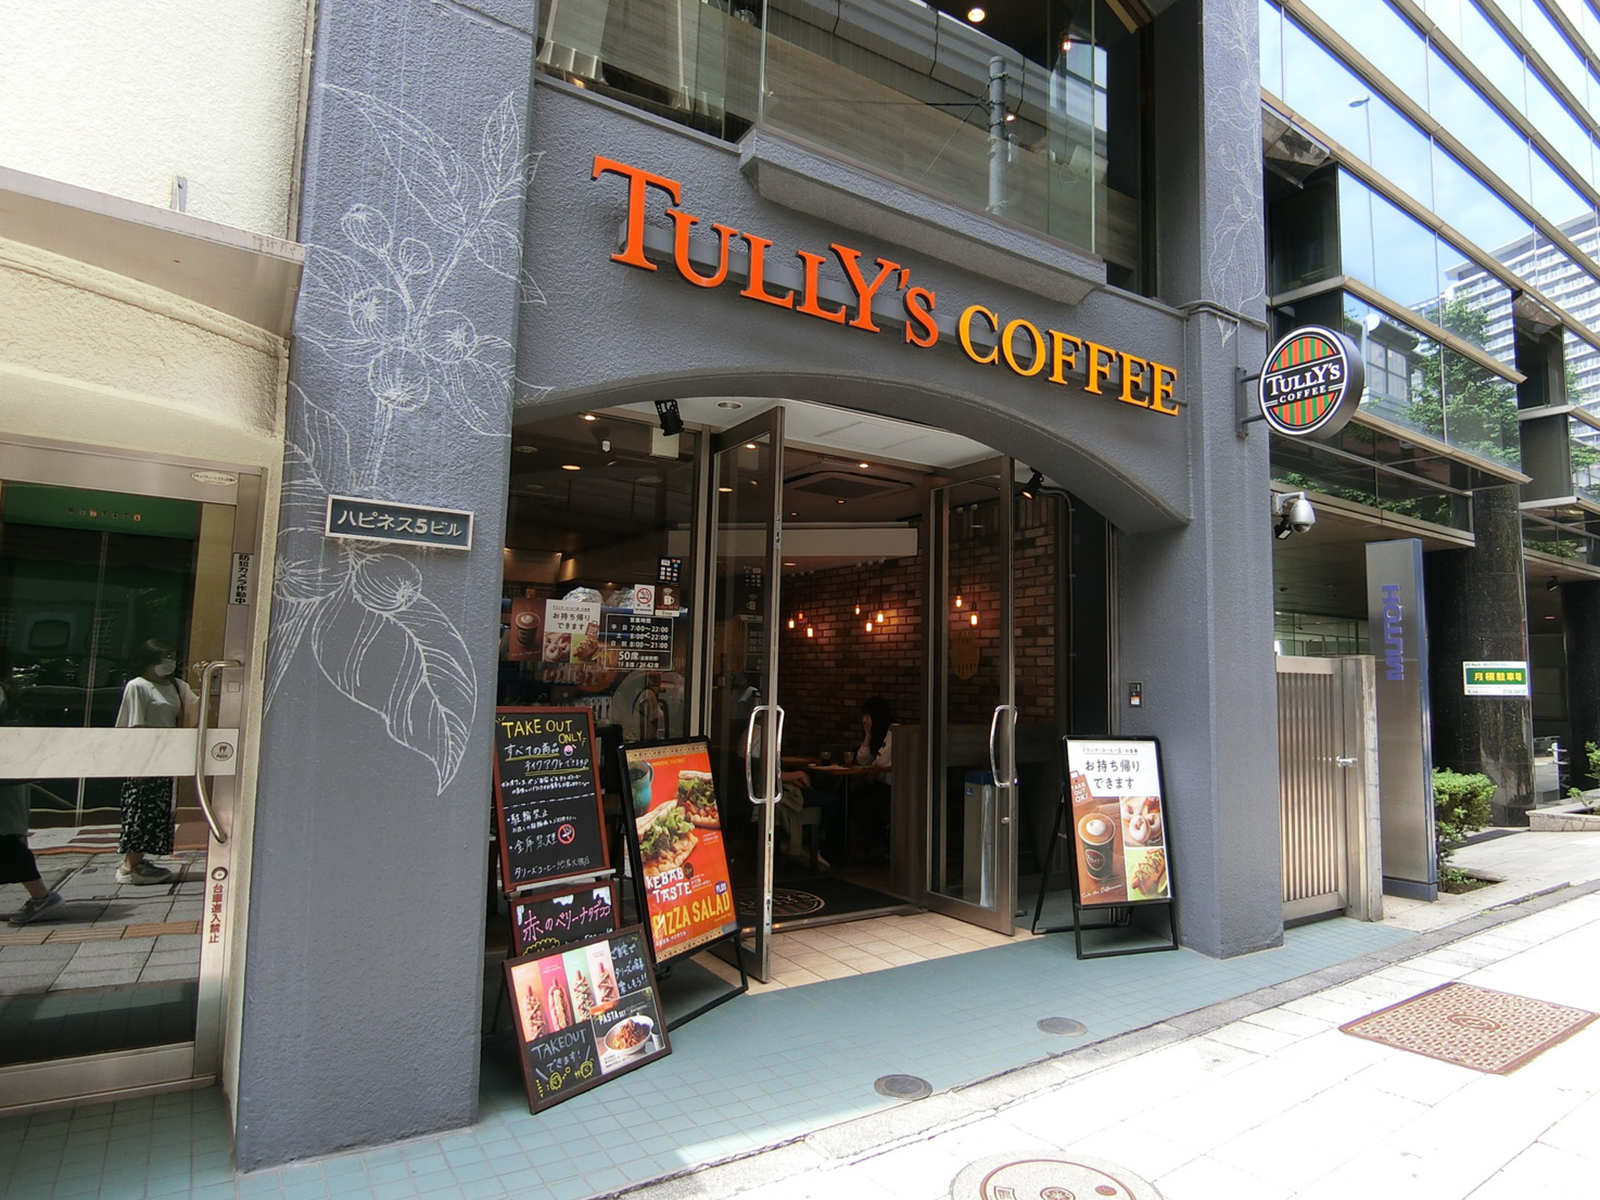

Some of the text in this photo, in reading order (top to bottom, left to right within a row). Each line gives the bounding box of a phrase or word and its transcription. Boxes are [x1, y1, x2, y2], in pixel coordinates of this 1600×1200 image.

[590, 154, 1179, 416] TULLY'S COFFEE
[1266, 362, 1341, 396] TULLY'S
[1279, 384, 1327, 404] COFFEE
[337, 509, 462, 537] ハピネス5ビル
[235, 554, 249, 605] 防犯カメラ作動中
[553, 612, 590, 621] お持ち帰り
[557, 622, 586, 631] できます
[1381, 584, 1404, 681] MUTOH
[1474, 672, 1522, 681] 月極駐車場
[502, 718, 573, 738] TAKE OUT
[558, 731, 583, 744] ONLY
[504, 742, 560, 759] すべての商品
[1085, 759, 1140, 772] お持ち帰り
[1094, 777, 1134, 790] できます
[646, 867, 684, 890] KEBAB
[653, 882, 692, 904] TASTE
[208, 883, 224, 944] 台車進入禁止
[652, 904, 691, 939] PIZZA
[692, 890, 731, 923] SALAD
[599, 1009, 619, 1025] PASTA
[531, 1028, 588, 1060] TAKEOUT
